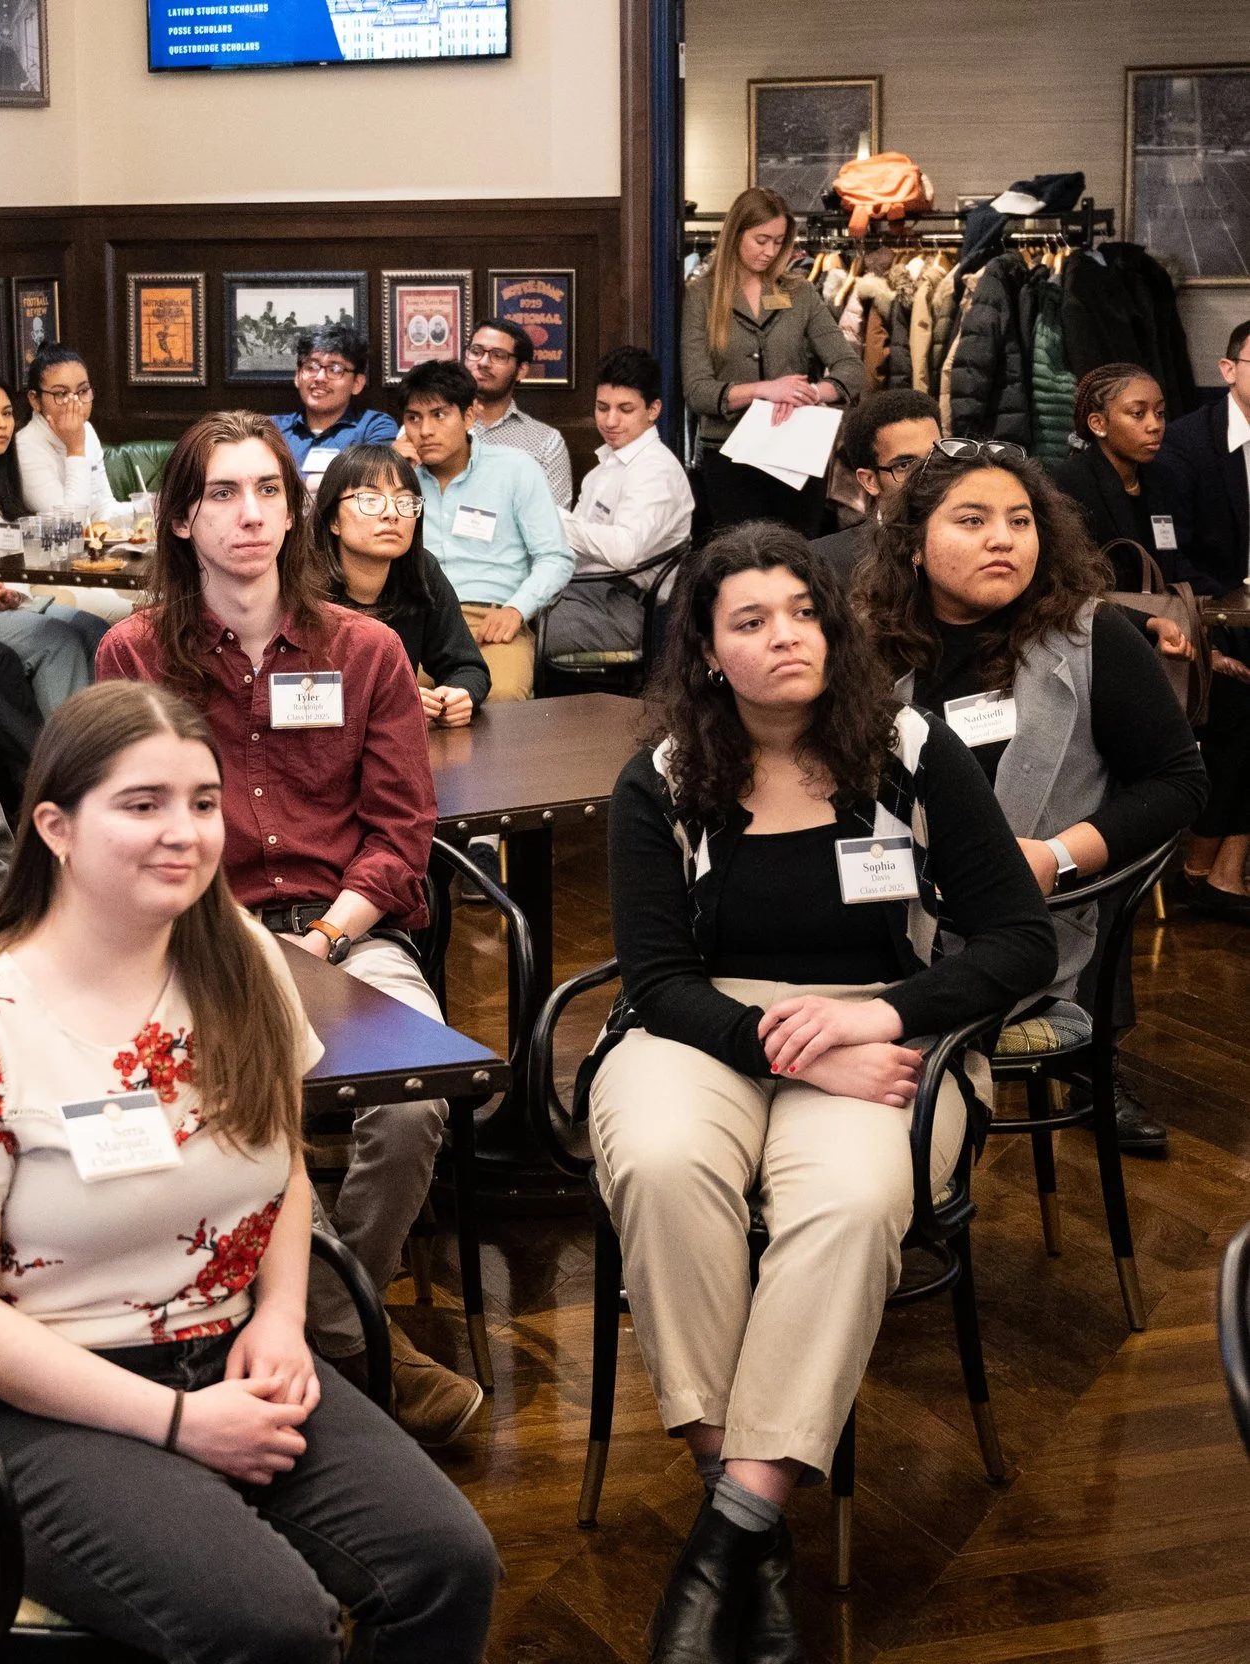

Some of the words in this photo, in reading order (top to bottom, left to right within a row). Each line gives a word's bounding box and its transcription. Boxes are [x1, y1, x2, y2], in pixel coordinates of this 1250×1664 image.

[168, 8, 195, 17] LATINO
[196, 6, 228, 16] STUDIES
[229, 4, 269, 14] SCHOLARS
[168, 27, 192, 35] POSSE
[194, 24, 232, 34] SCHOLARS
[168, 44, 219, 55] QUESTBRIDGE
[221, 42, 260, 52] SCHOLARS
[22, 295, 49, 308] FOOTBALL
[295, 693, 321, 704] Tyler
[862, 860, 896, 874] Sophia
[870, 874, 891, 882] Davis
[859, 886, 878, 895] Class
[879, 884, 887, 893] of
[888, 883, 906, 892] 2025
